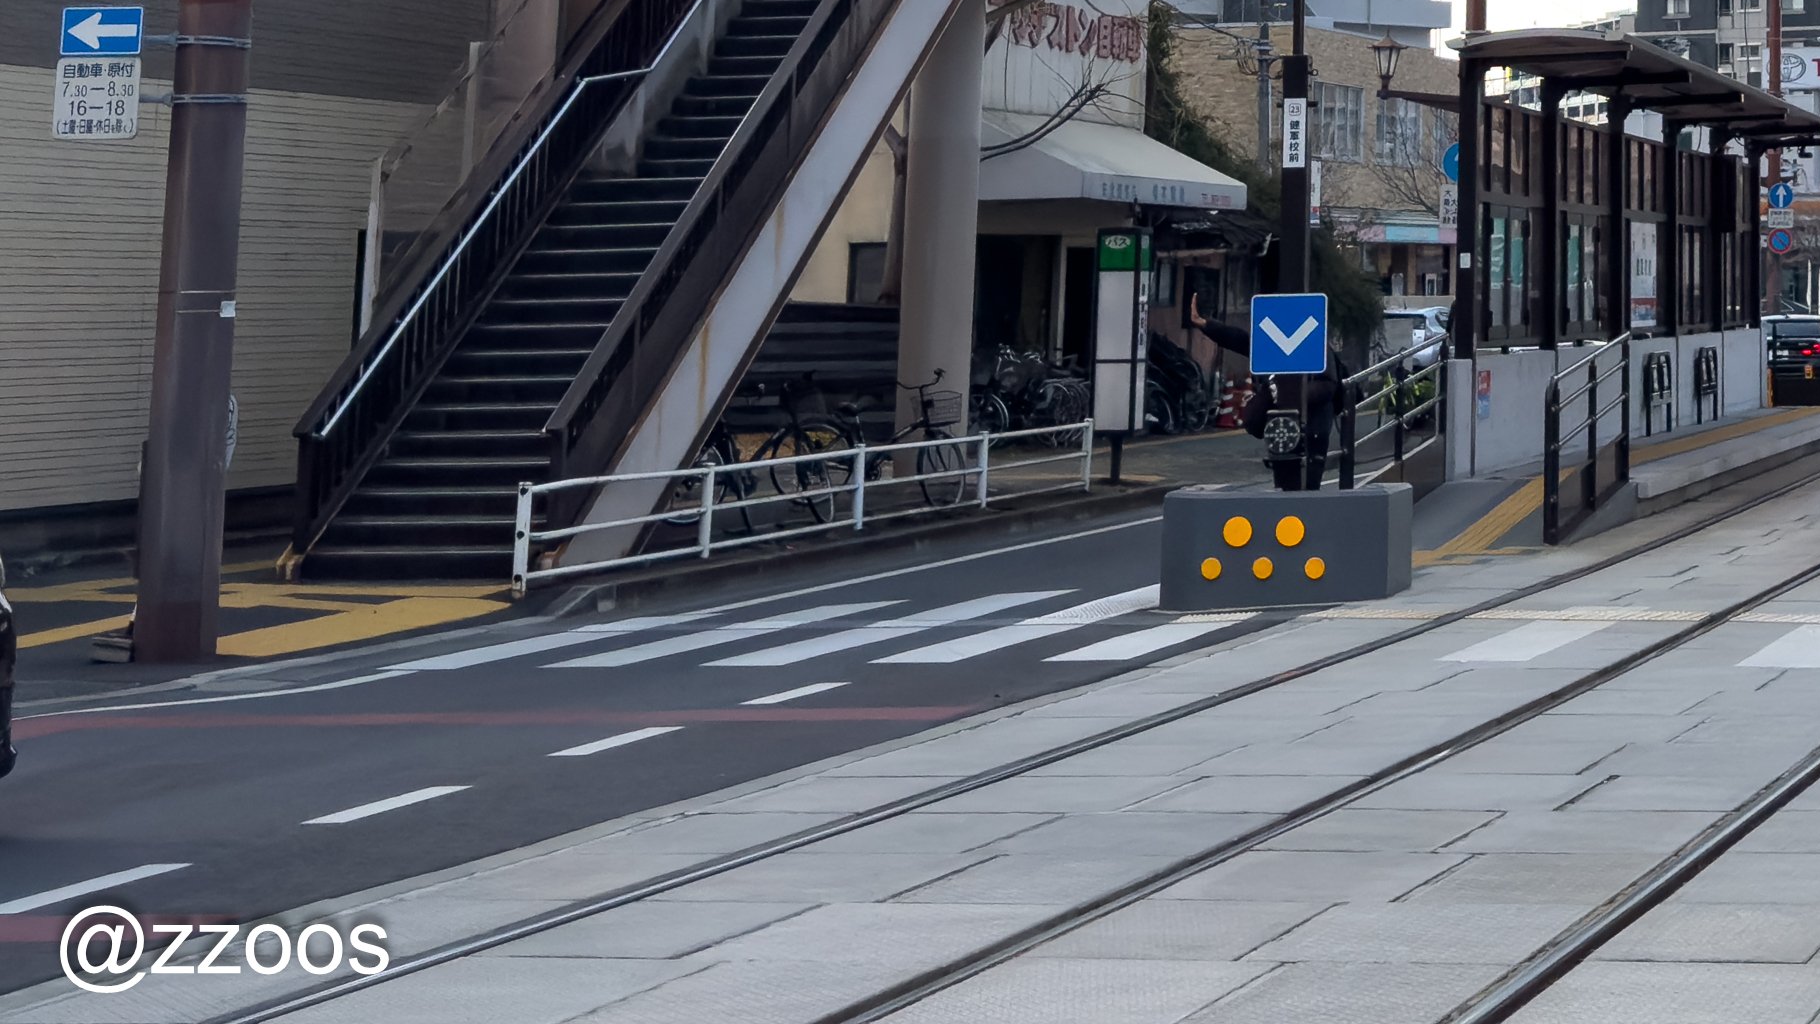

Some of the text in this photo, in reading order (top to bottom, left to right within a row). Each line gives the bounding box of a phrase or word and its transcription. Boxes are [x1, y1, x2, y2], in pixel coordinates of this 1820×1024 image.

[1288, 120, 1301, 163] 健軍校前
[1107, 237, 1130, 247] バス
